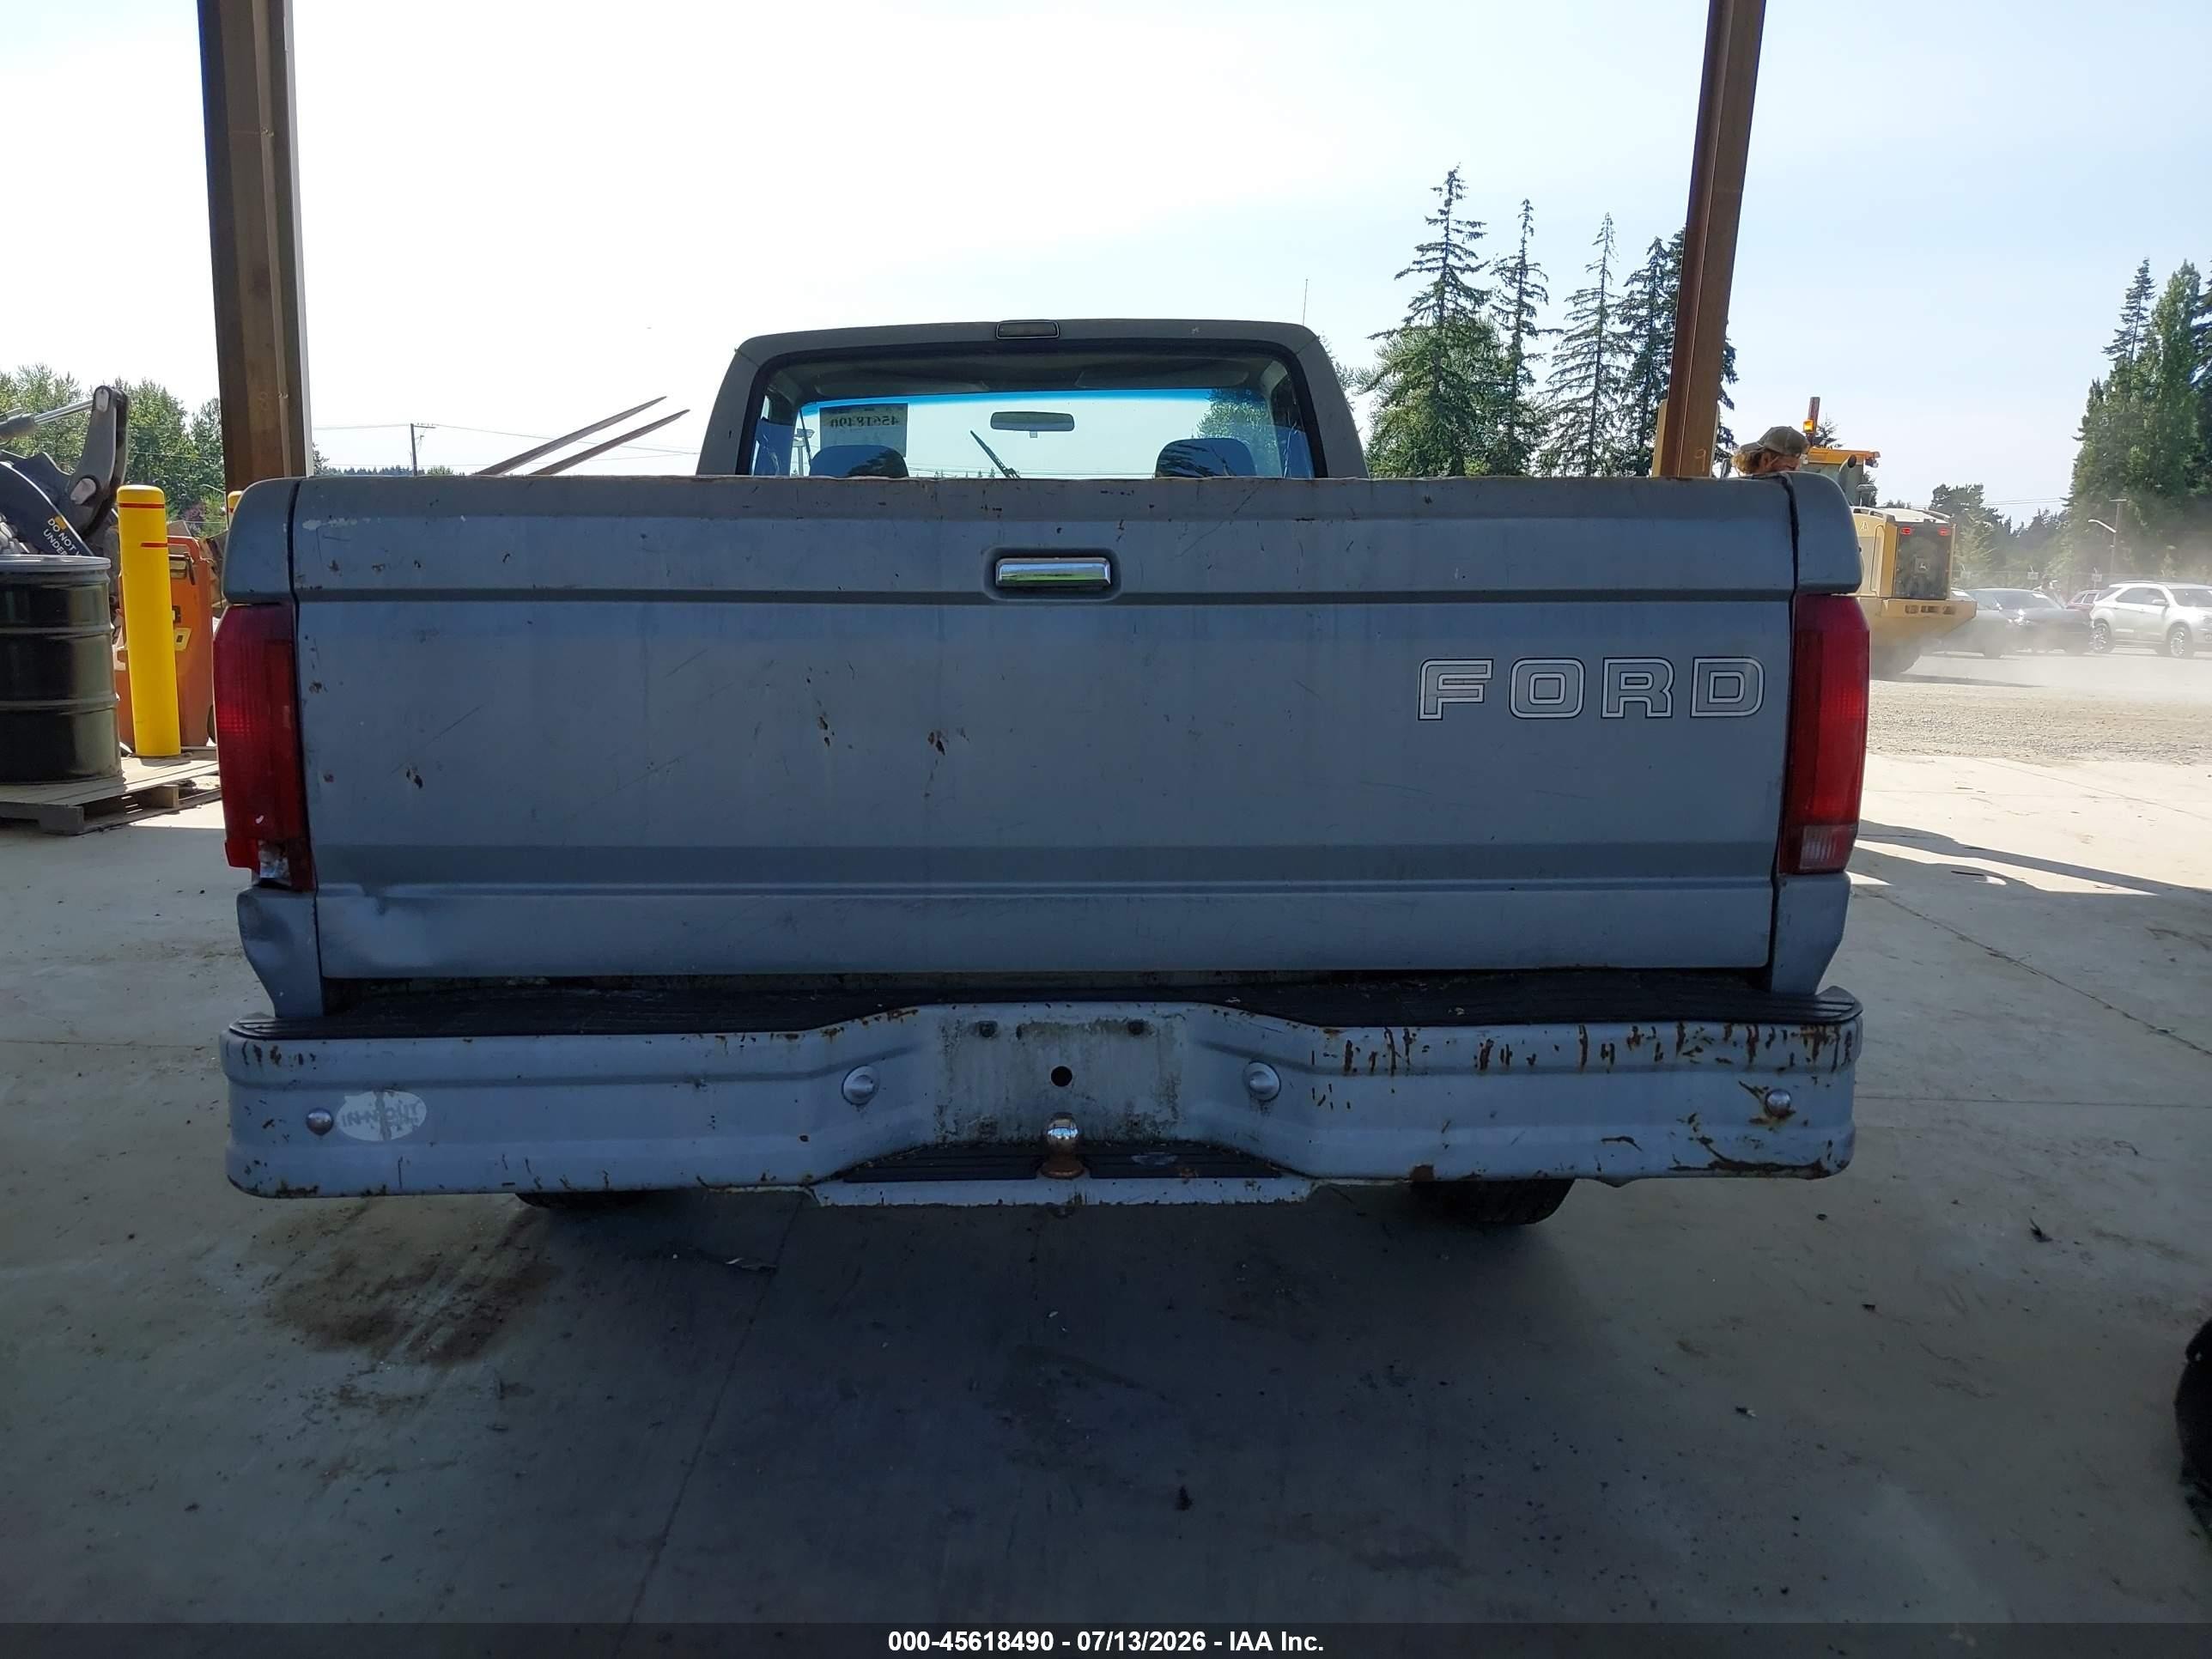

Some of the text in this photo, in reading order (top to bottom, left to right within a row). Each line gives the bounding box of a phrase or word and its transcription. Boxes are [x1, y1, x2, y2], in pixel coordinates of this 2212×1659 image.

[47, 518, 77, 551] DO NOT
[1417, 657, 1765, 720] FORD
